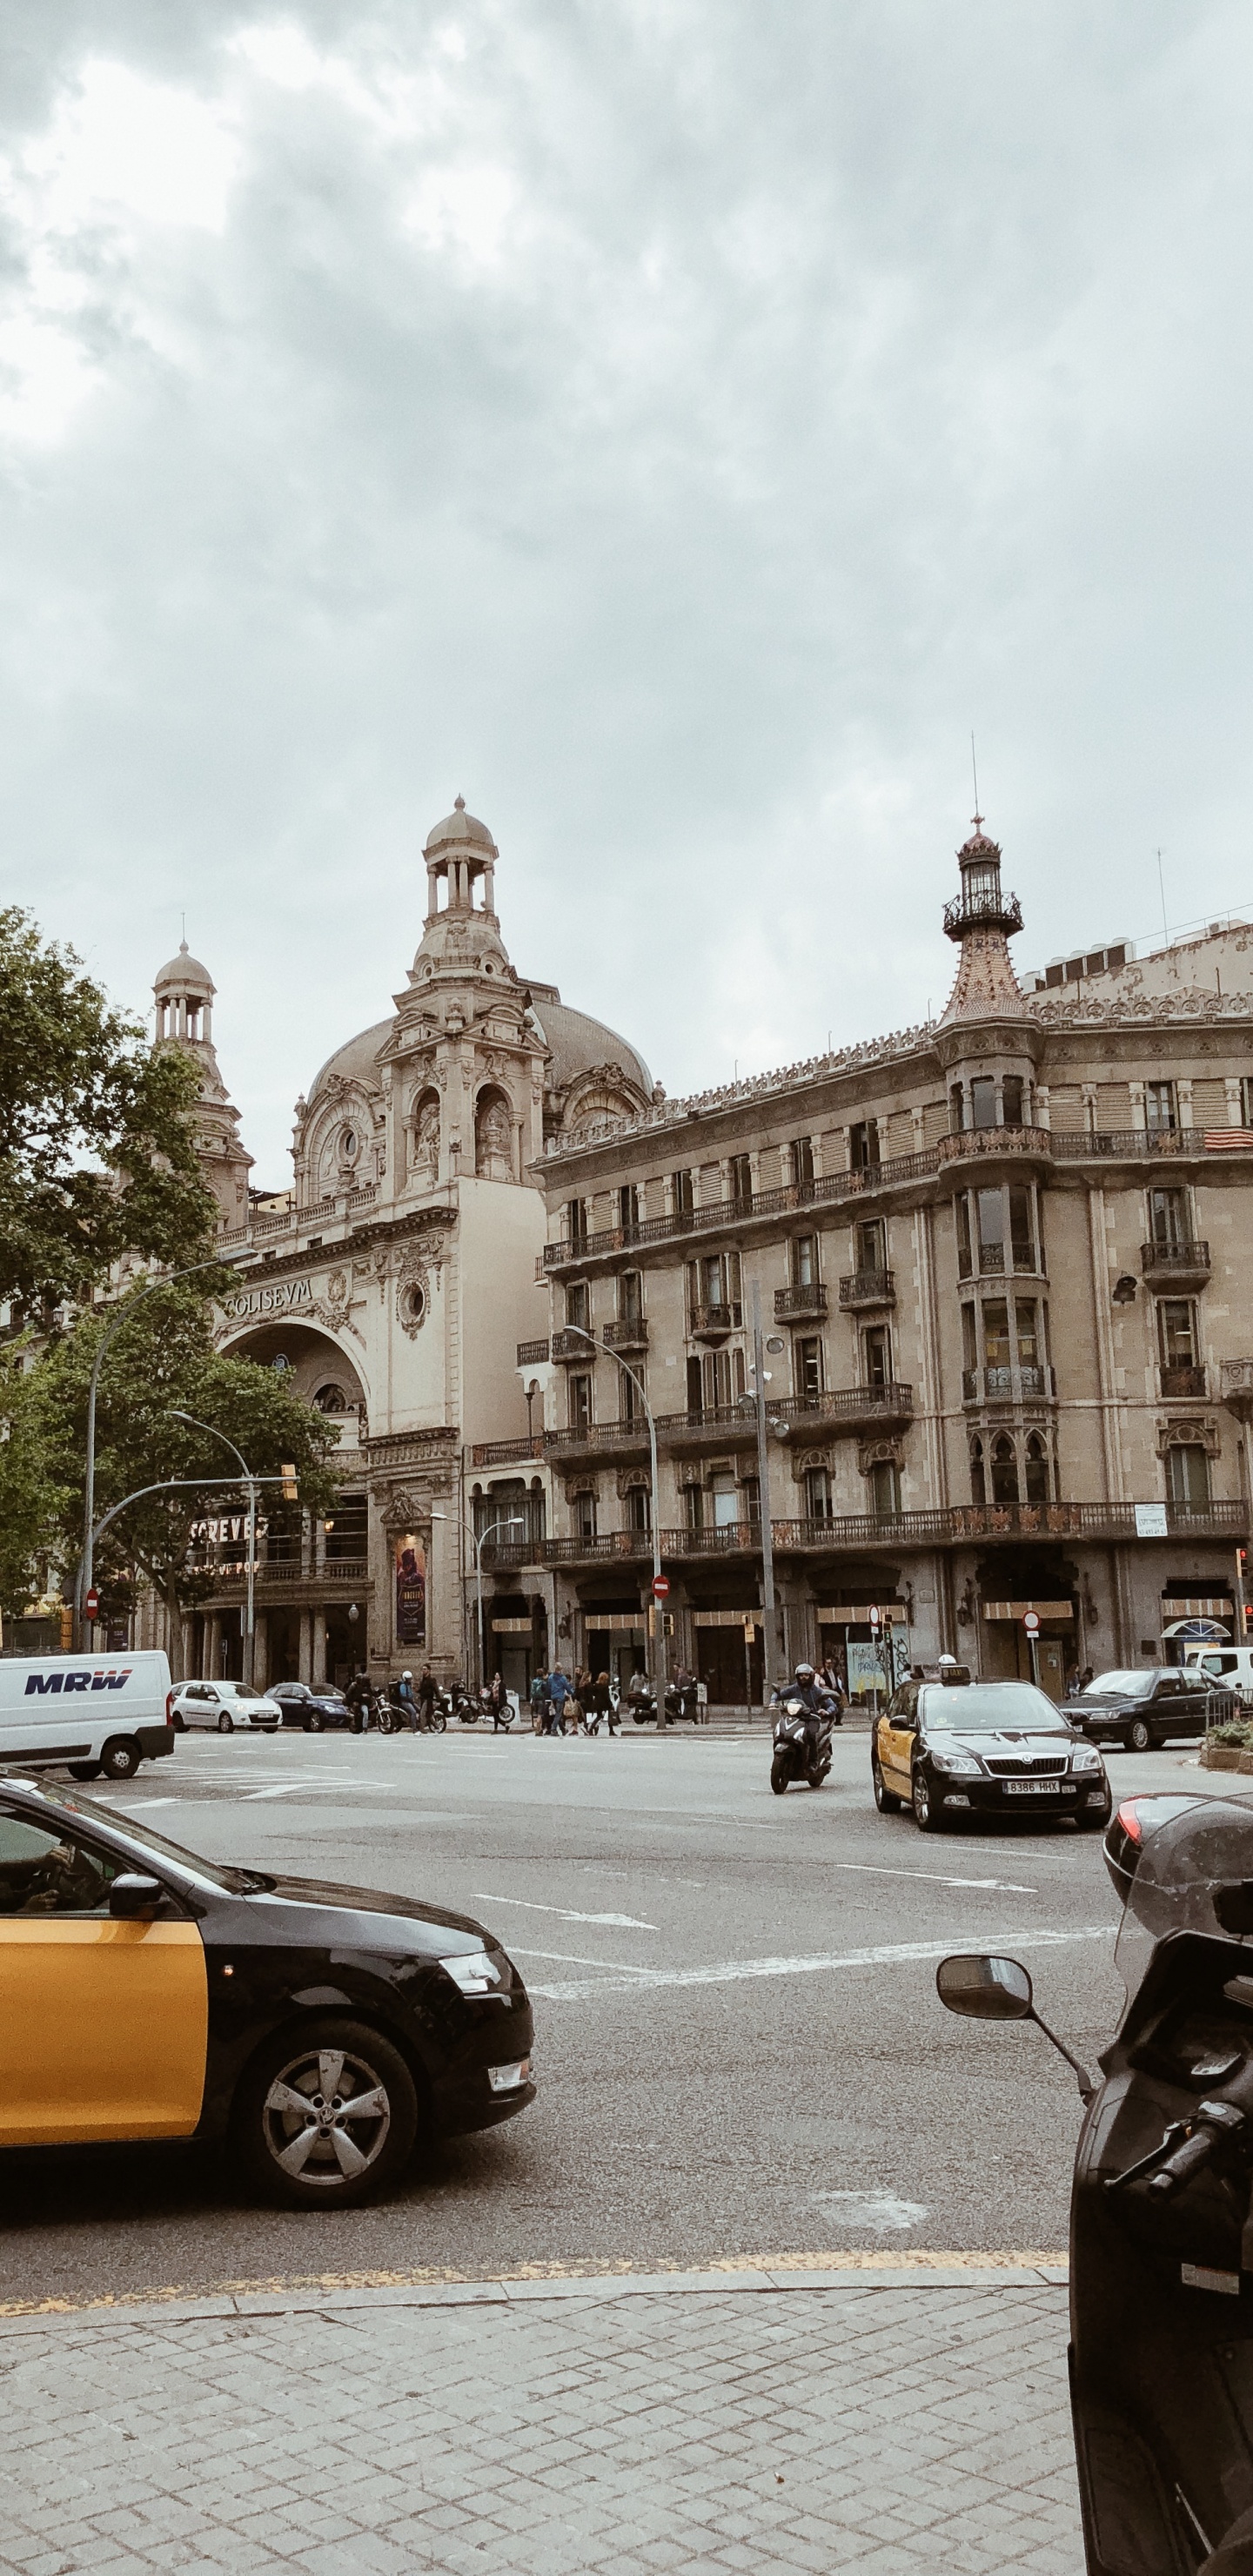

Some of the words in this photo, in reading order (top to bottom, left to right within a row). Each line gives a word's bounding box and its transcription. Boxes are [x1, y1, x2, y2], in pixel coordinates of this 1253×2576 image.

[226, 1279, 312, 1316] COLISEVM
[24, 1669, 133, 1695] MRW
[1010, 1782, 1035, 1792] 8386
[1039, 1781, 1057, 1792] HHX
